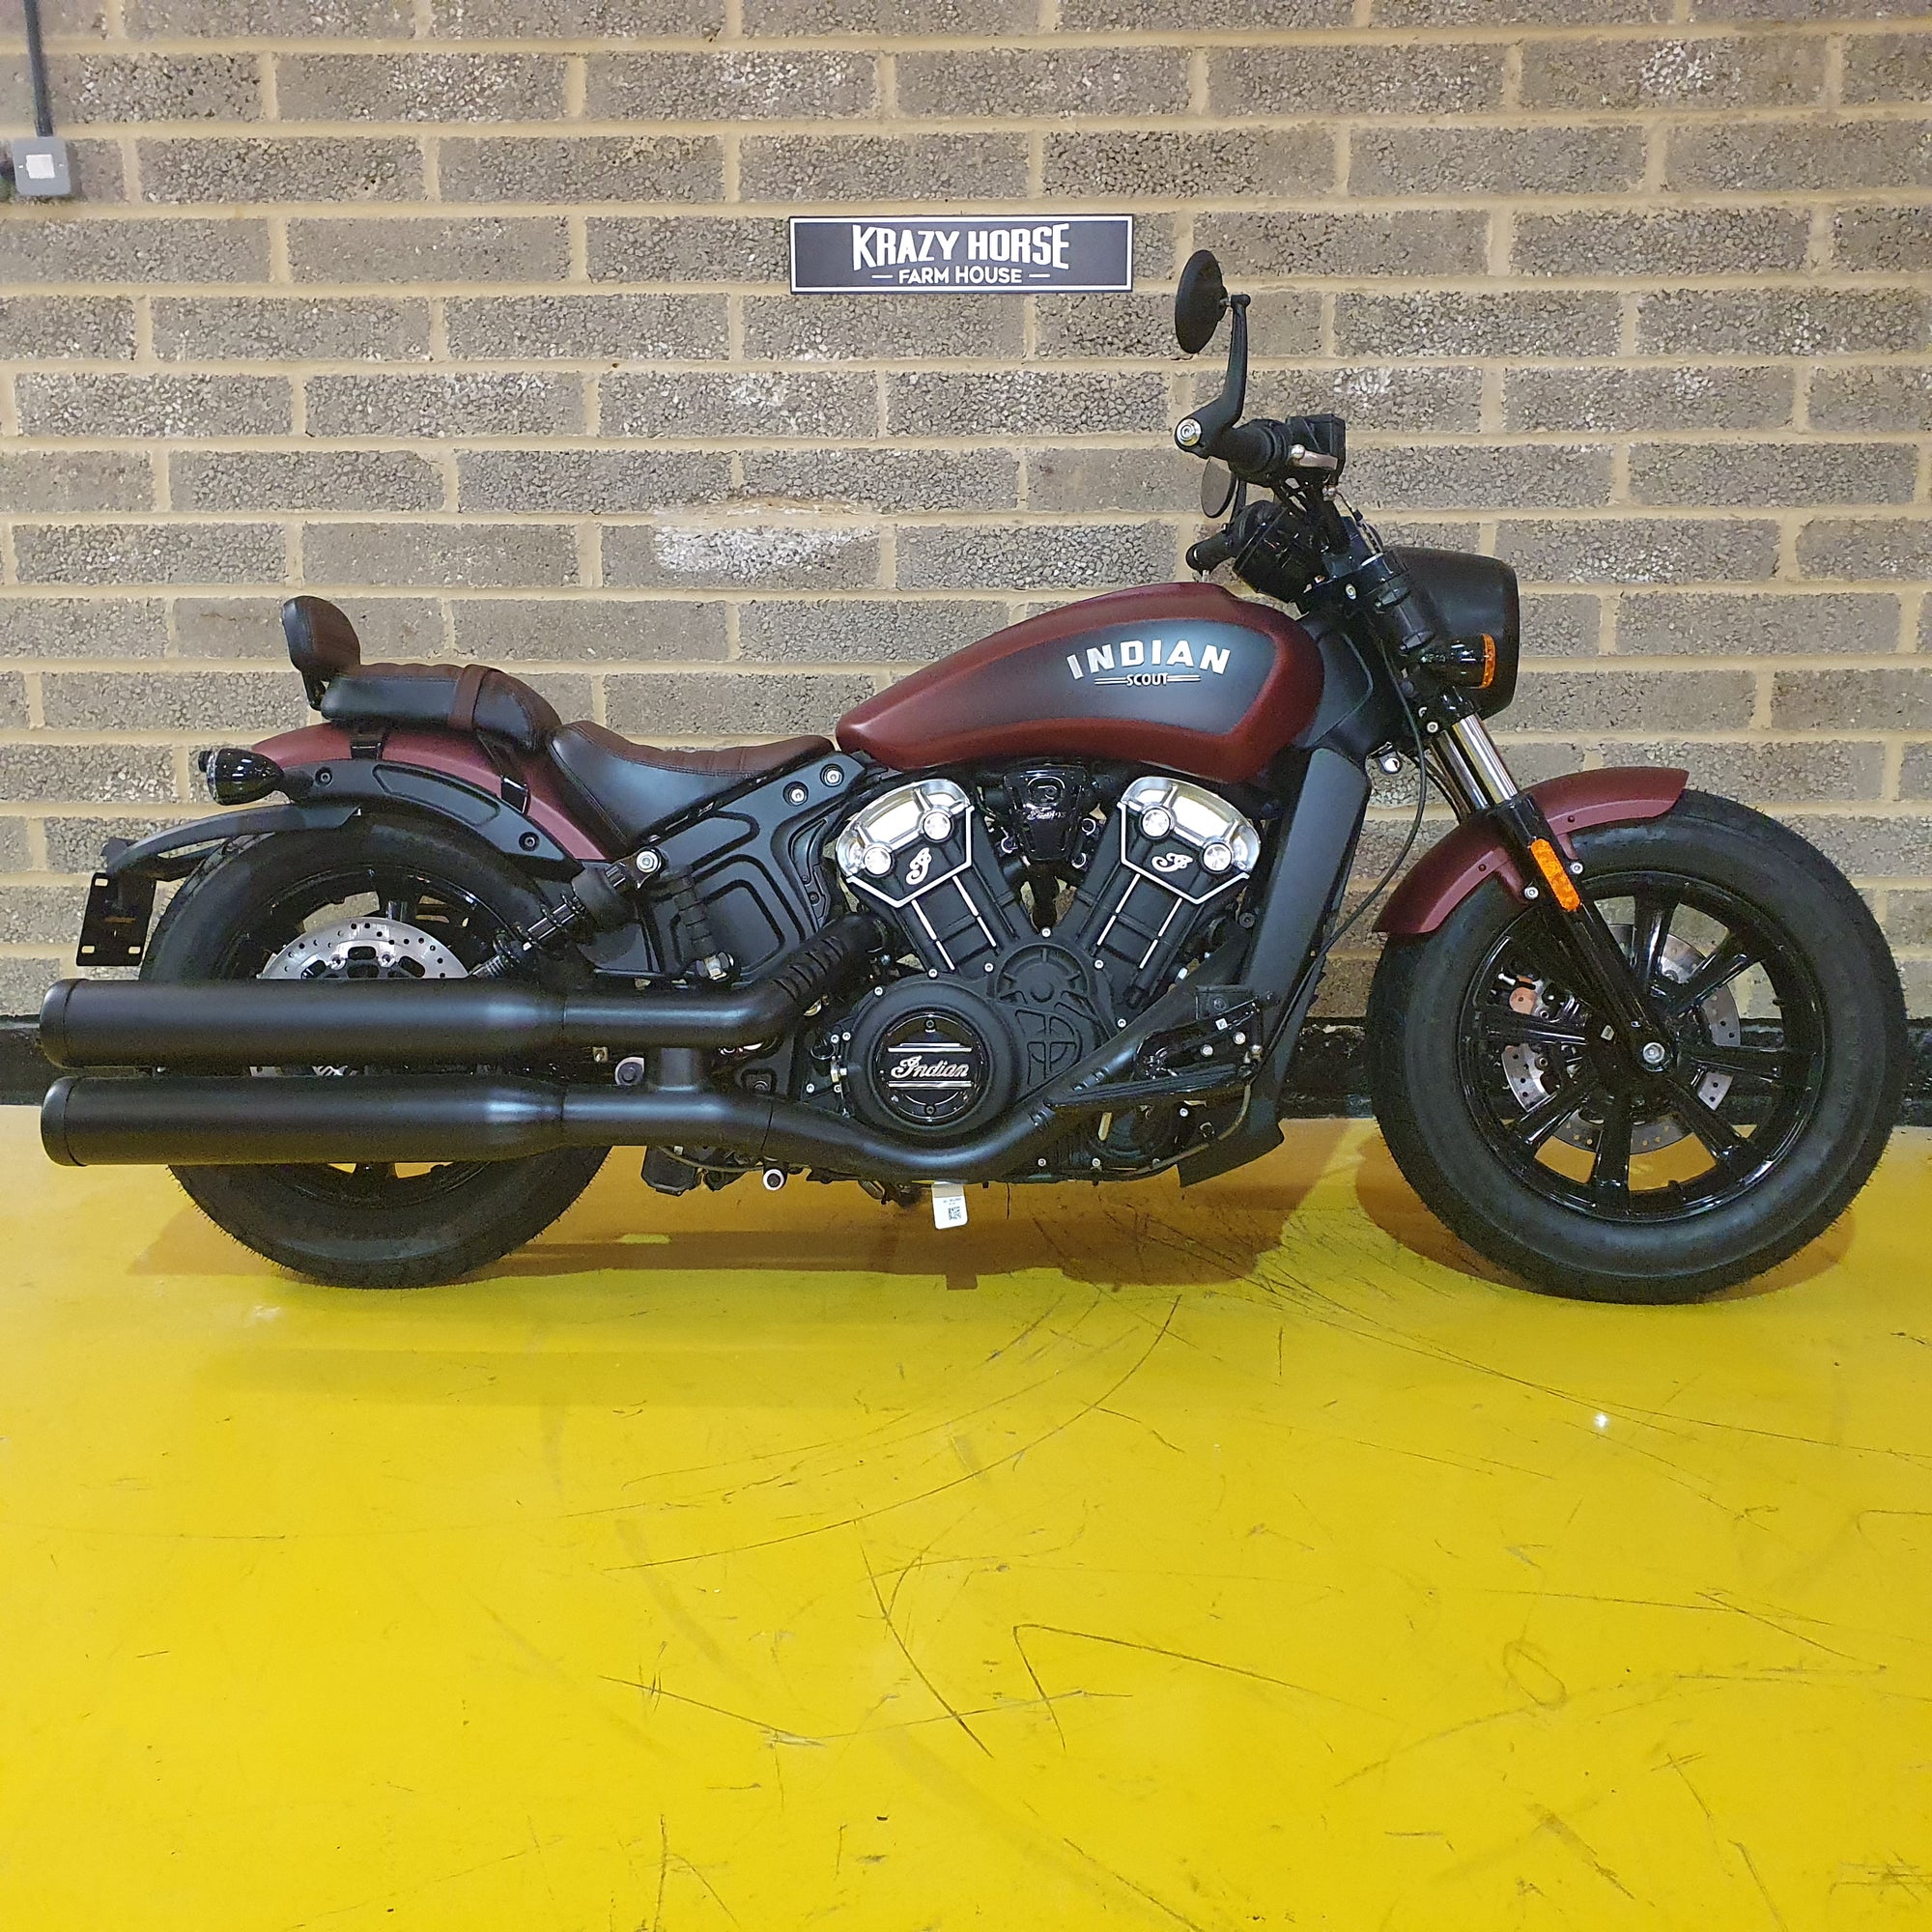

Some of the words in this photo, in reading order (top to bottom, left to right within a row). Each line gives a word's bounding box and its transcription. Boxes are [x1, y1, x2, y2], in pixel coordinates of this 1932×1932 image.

[852, 224, 960, 271] KRAZY
[966, 223, 1070, 270] HORSE
[897, 268, 950, 284] FARM
[955, 265, 1023, 284] HOUSE
[1065, 639, 1232, 680] INDIAN
[1125, 672, 1169, 686] SCOUT
[890, 1055, 971, 1079] Indian
